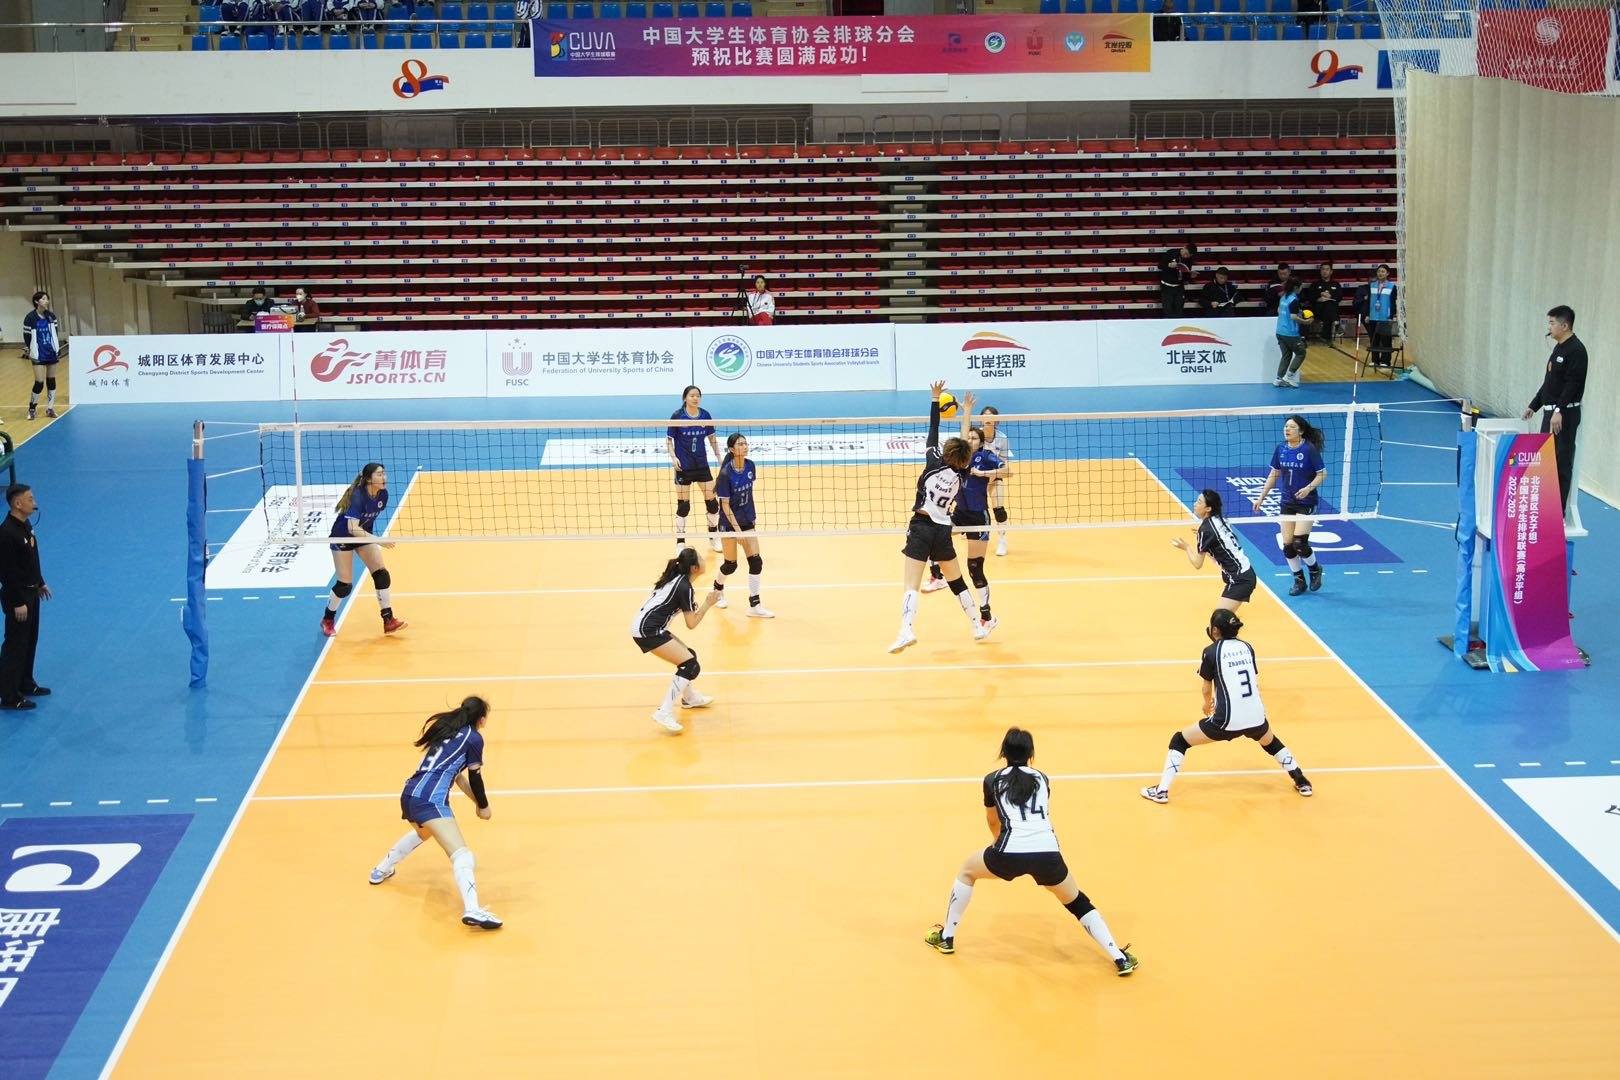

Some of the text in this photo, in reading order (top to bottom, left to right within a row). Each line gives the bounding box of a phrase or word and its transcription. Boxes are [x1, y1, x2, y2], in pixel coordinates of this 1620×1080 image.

[569, 31, 616, 50] CUVA
[643, 25, 915, 46] 中国大学生体育协会排球分会
[691, 46, 867, 66] 预祝比赛圆满成功!
[138, 353, 265, 367] 城阳区体育发展中心
[374, 350, 447, 371] 菁体育
[542, 350, 674, 366] 中国大学生体育协会
[756, 347, 880, 360] 中国大学生体育协会排球分会
[1166, 350, 1227, 365] 北岸文体
[967, 354, 1026, 369] 北岸控股
[209, 368, 246, 376] Development
[542, 367, 578, 375] Federation
[587, 366, 621, 375] University
[622, 366, 645, 374] Sports
[654, 365, 674, 373] China
[981, 370, 1013, 378] QNSH
[1180, 365, 1213, 373] QNSH
[346, 372, 446, 385] JSPORTS.CN
[505, 378, 529, 387] FUSC
[1518, 452, 1542, 462] CUVA
[1507, 475, 1518, 519] 2022-2023
[1237, 669, 1253, 698] 3
